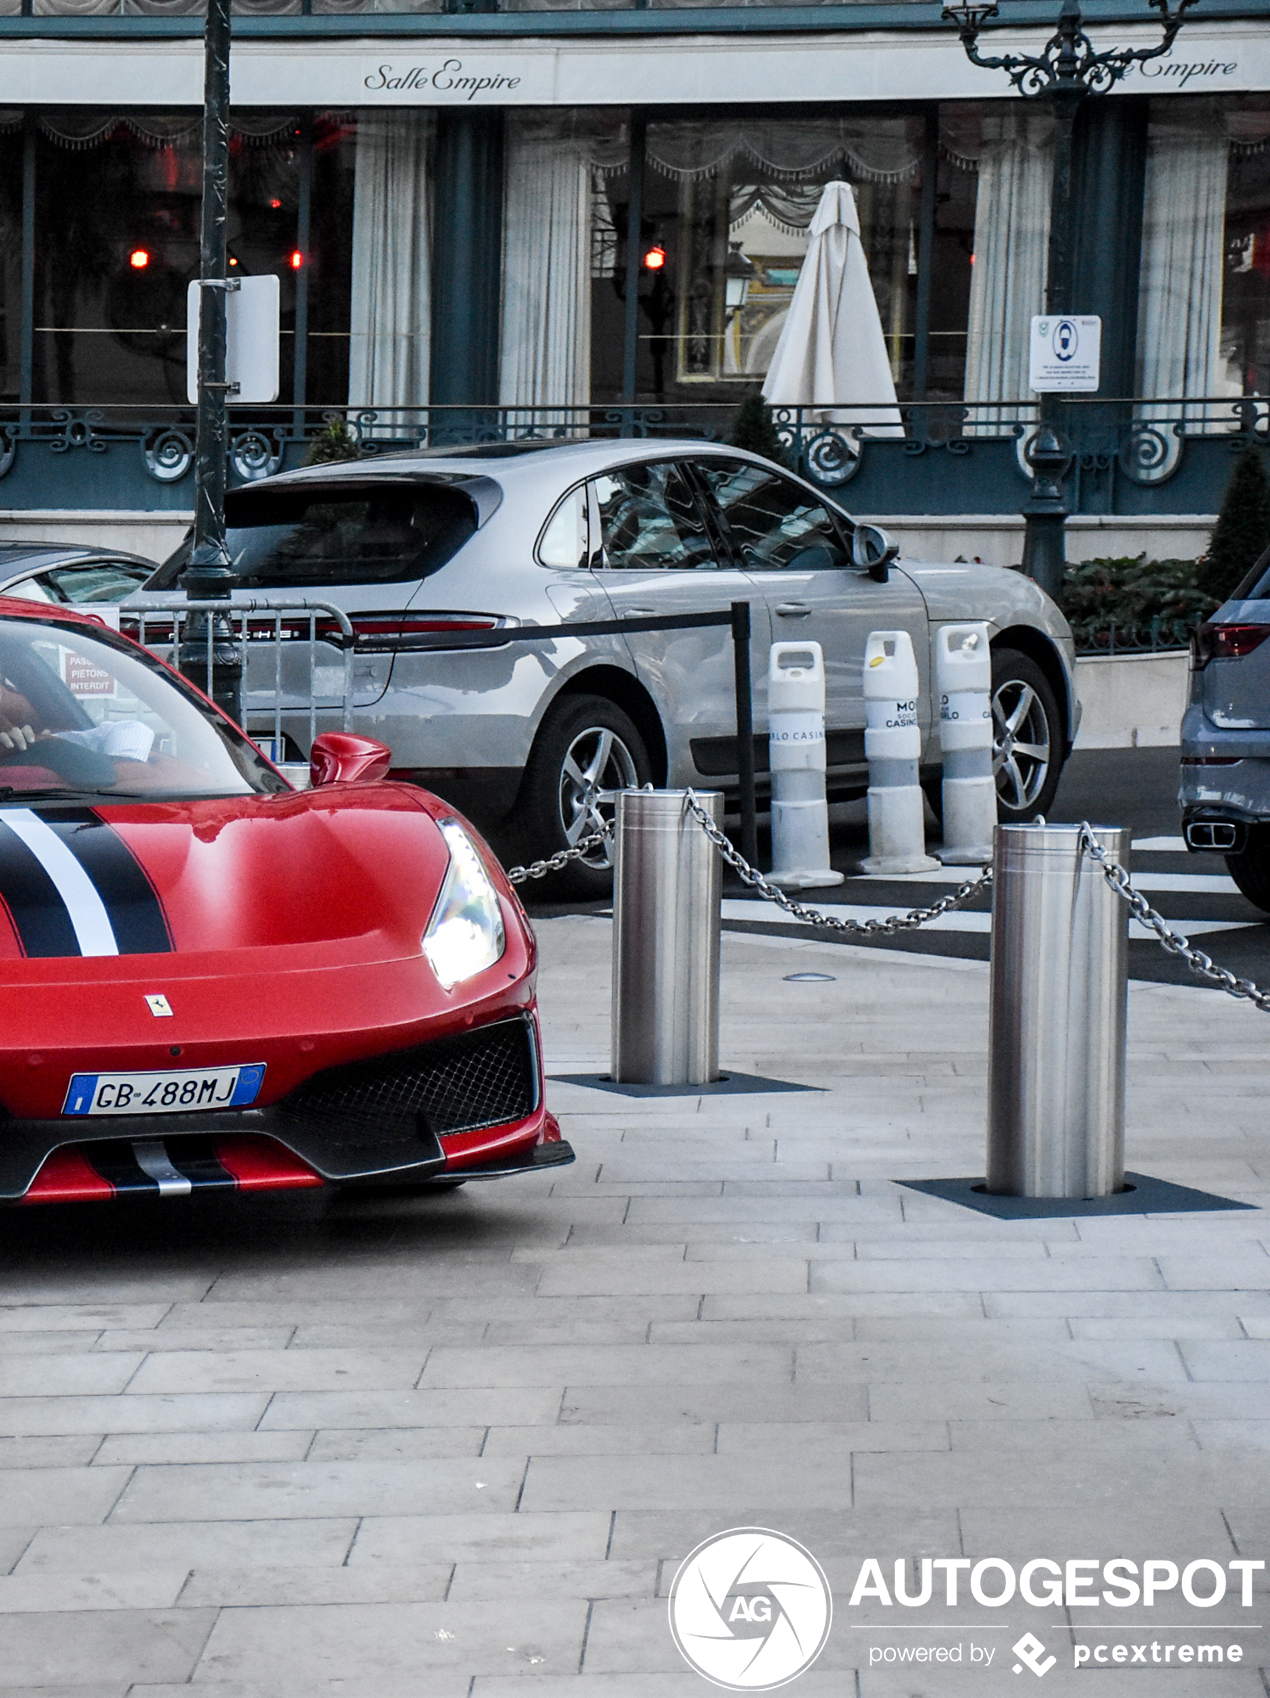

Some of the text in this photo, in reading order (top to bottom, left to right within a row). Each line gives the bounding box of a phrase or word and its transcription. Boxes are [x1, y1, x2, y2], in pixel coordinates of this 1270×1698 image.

[364, 59, 521, 100] Salle Empire
[70, 682, 109, 690] INTERDIT
